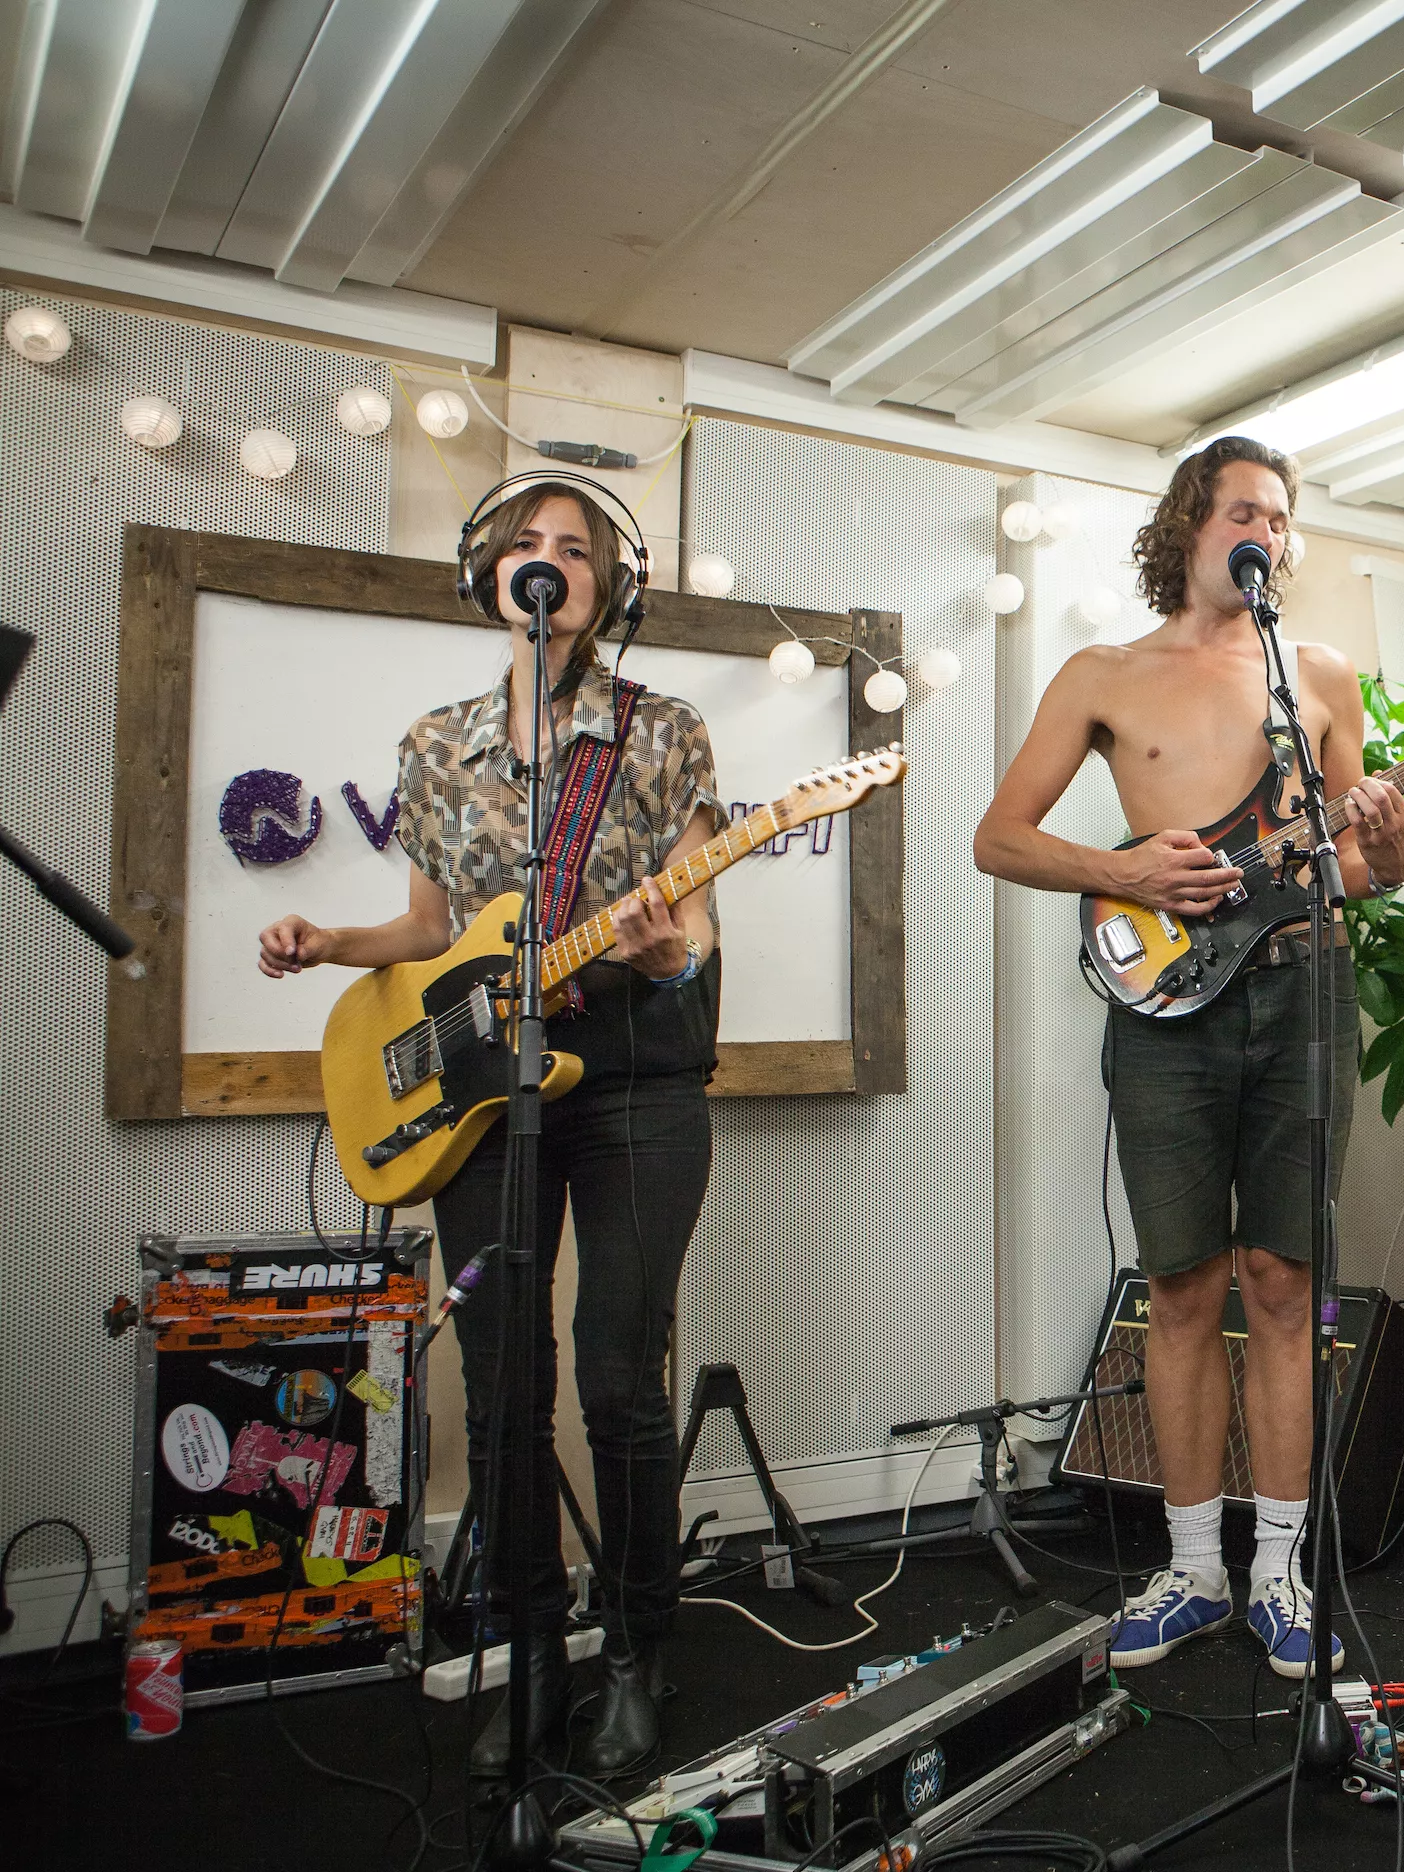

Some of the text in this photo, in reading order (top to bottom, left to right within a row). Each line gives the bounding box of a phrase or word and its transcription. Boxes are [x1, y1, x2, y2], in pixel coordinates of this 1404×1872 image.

[242, 1262, 384, 1290] SHURE
[189, 1412, 211, 1464] Beyond.com
[189, 1441, 198, 1453] and
[179, 1443, 194, 1474] Strings
